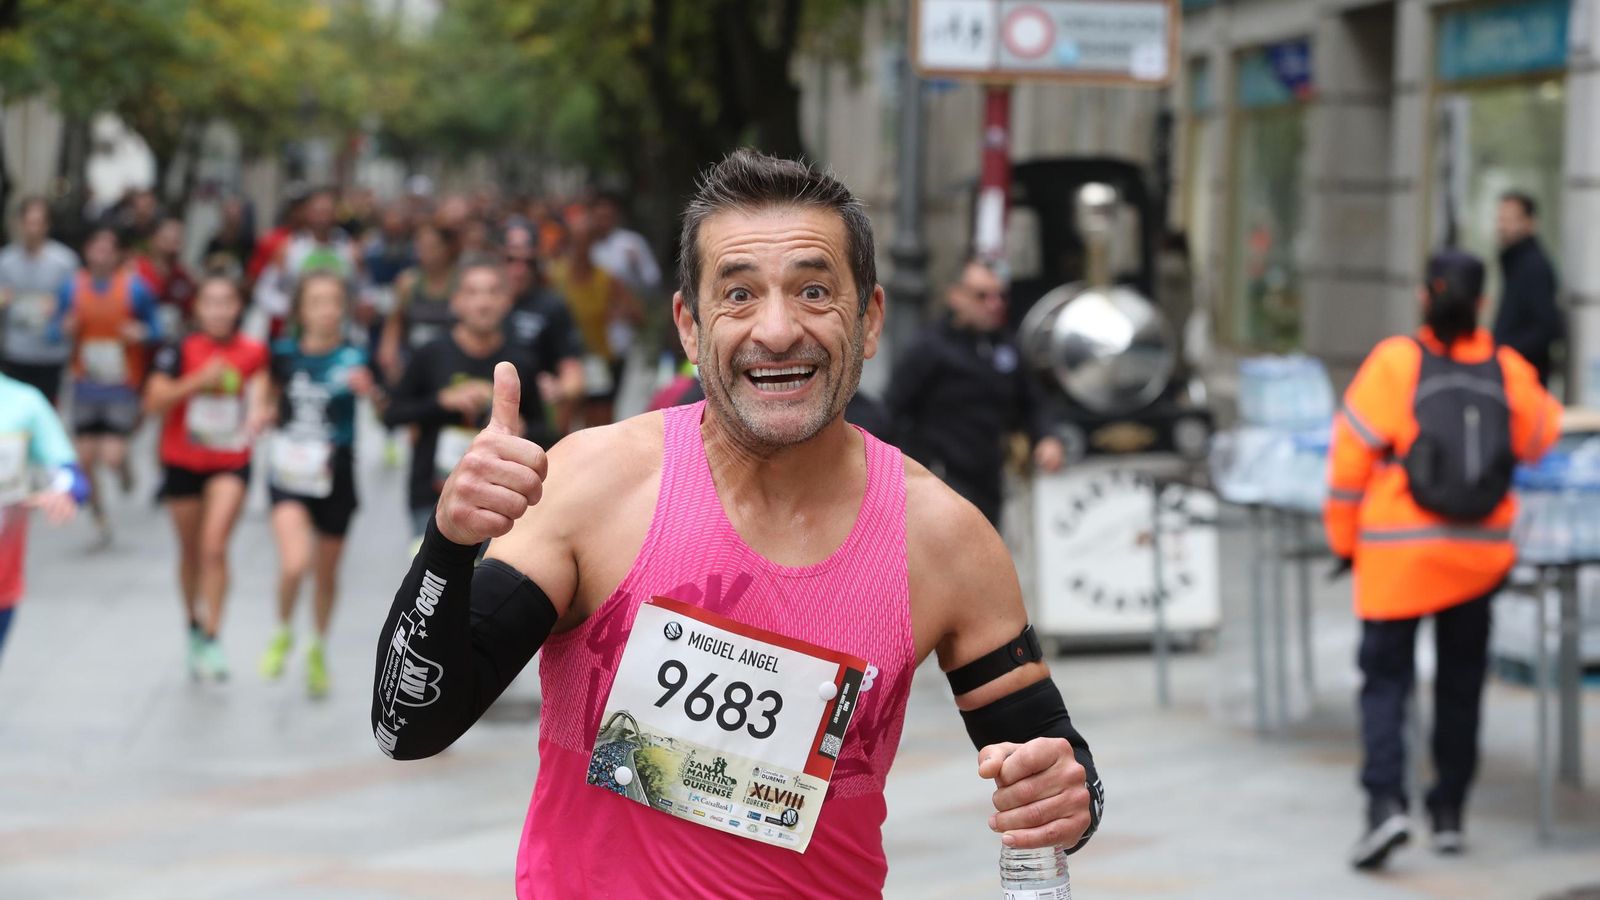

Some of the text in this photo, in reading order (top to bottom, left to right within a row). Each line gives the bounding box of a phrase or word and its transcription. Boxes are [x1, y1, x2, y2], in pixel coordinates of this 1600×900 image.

[687, 630, 779, 674] MIGUEL ANGEL
[400, 657, 429, 701] XIV
[653, 659, 784, 740] 9683
[689, 760, 712, 773] SAN
[686, 767, 729, 786] MARTIN
[761, 773, 787, 784] OURENSE
[700, 797, 729, 811] CaixaBank
[746, 797, 771, 809] OURENSE
[749, 781, 805, 810] XLVIII
